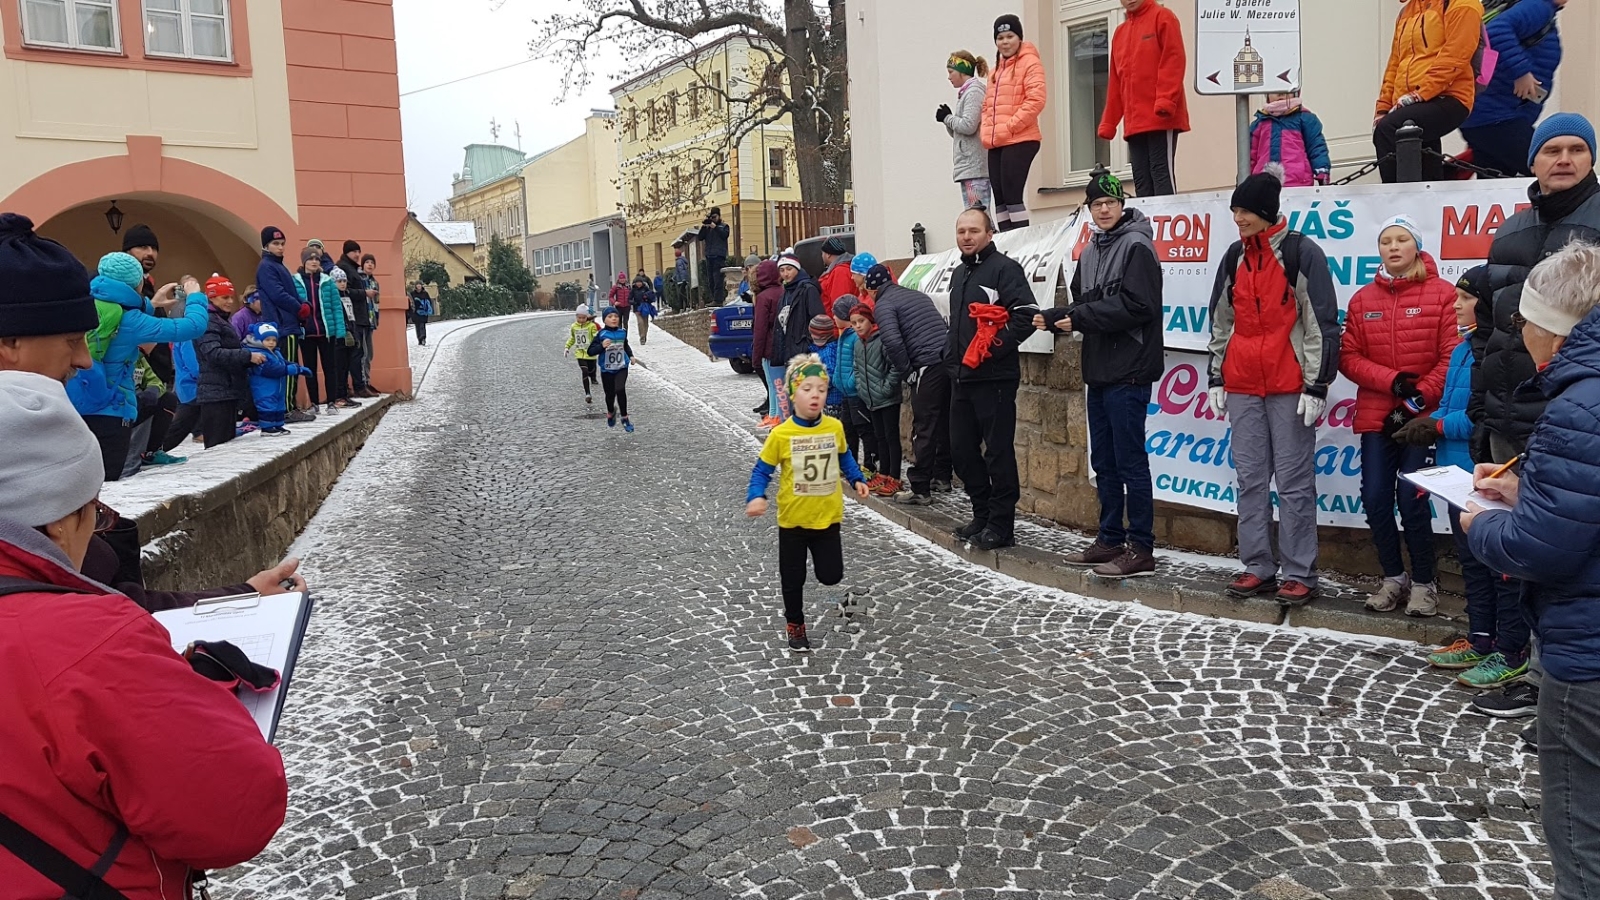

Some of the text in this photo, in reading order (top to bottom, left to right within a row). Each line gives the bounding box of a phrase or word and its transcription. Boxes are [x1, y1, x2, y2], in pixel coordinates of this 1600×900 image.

[1200, 9, 1296, 19] Julie W. Mezerové
[1168, 244, 1204, 258] stav
[608, 351, 623, 364] 60
[803, 453, 831, 482] 57
